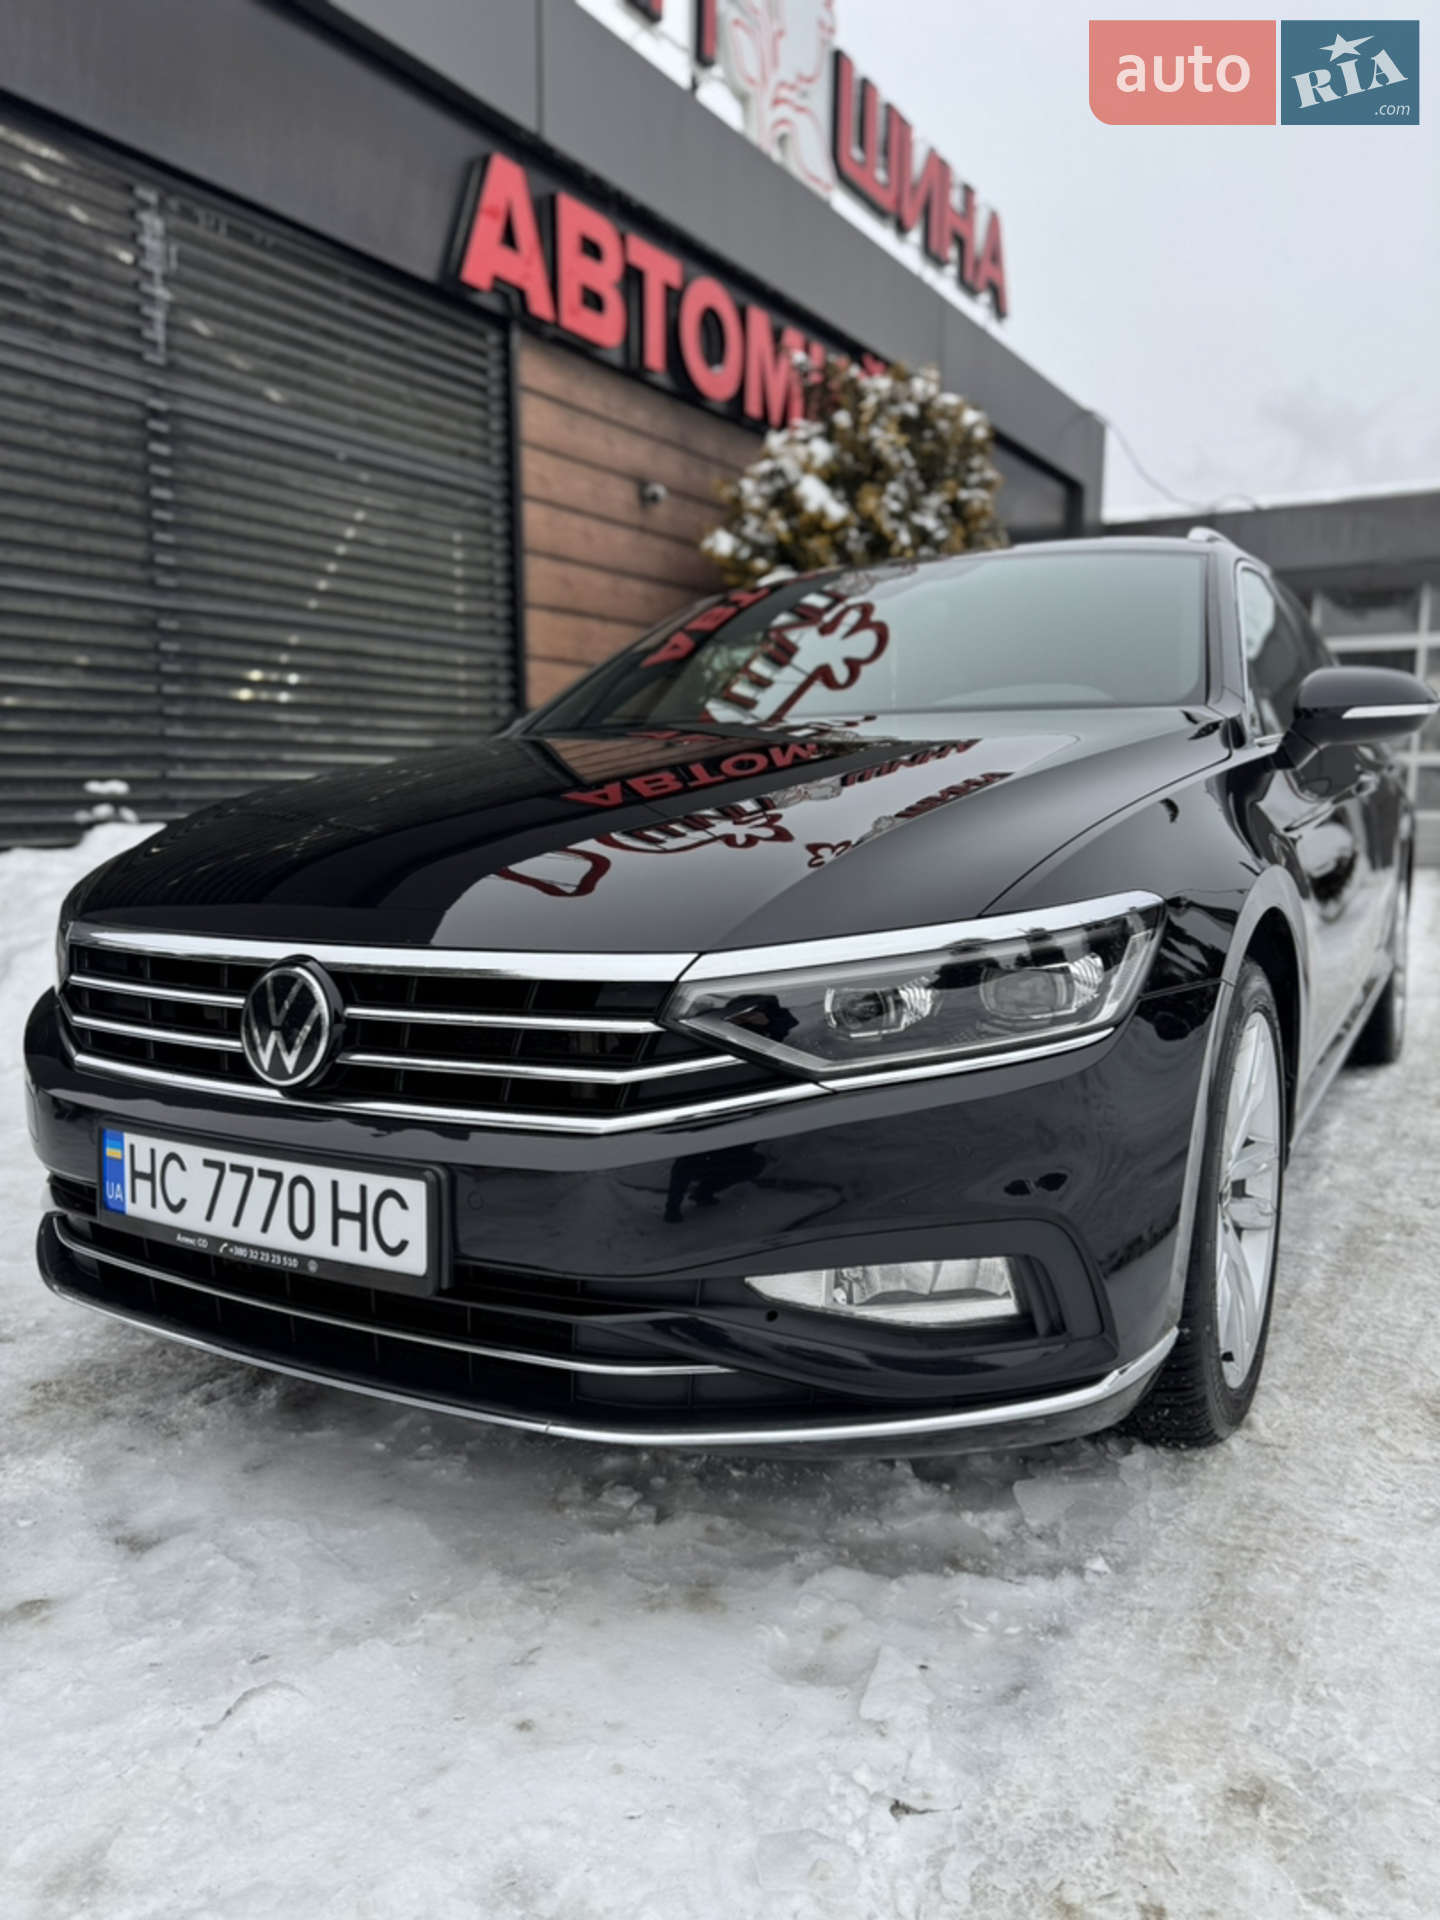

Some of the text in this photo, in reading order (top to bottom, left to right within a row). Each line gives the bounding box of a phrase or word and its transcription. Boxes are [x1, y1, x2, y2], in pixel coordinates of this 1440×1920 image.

[833, 49, 1006, 322] ШИНА
[106, 1181, 123, 1201] UA
[129, 1143, 409, 1257] HC 7770 HC
